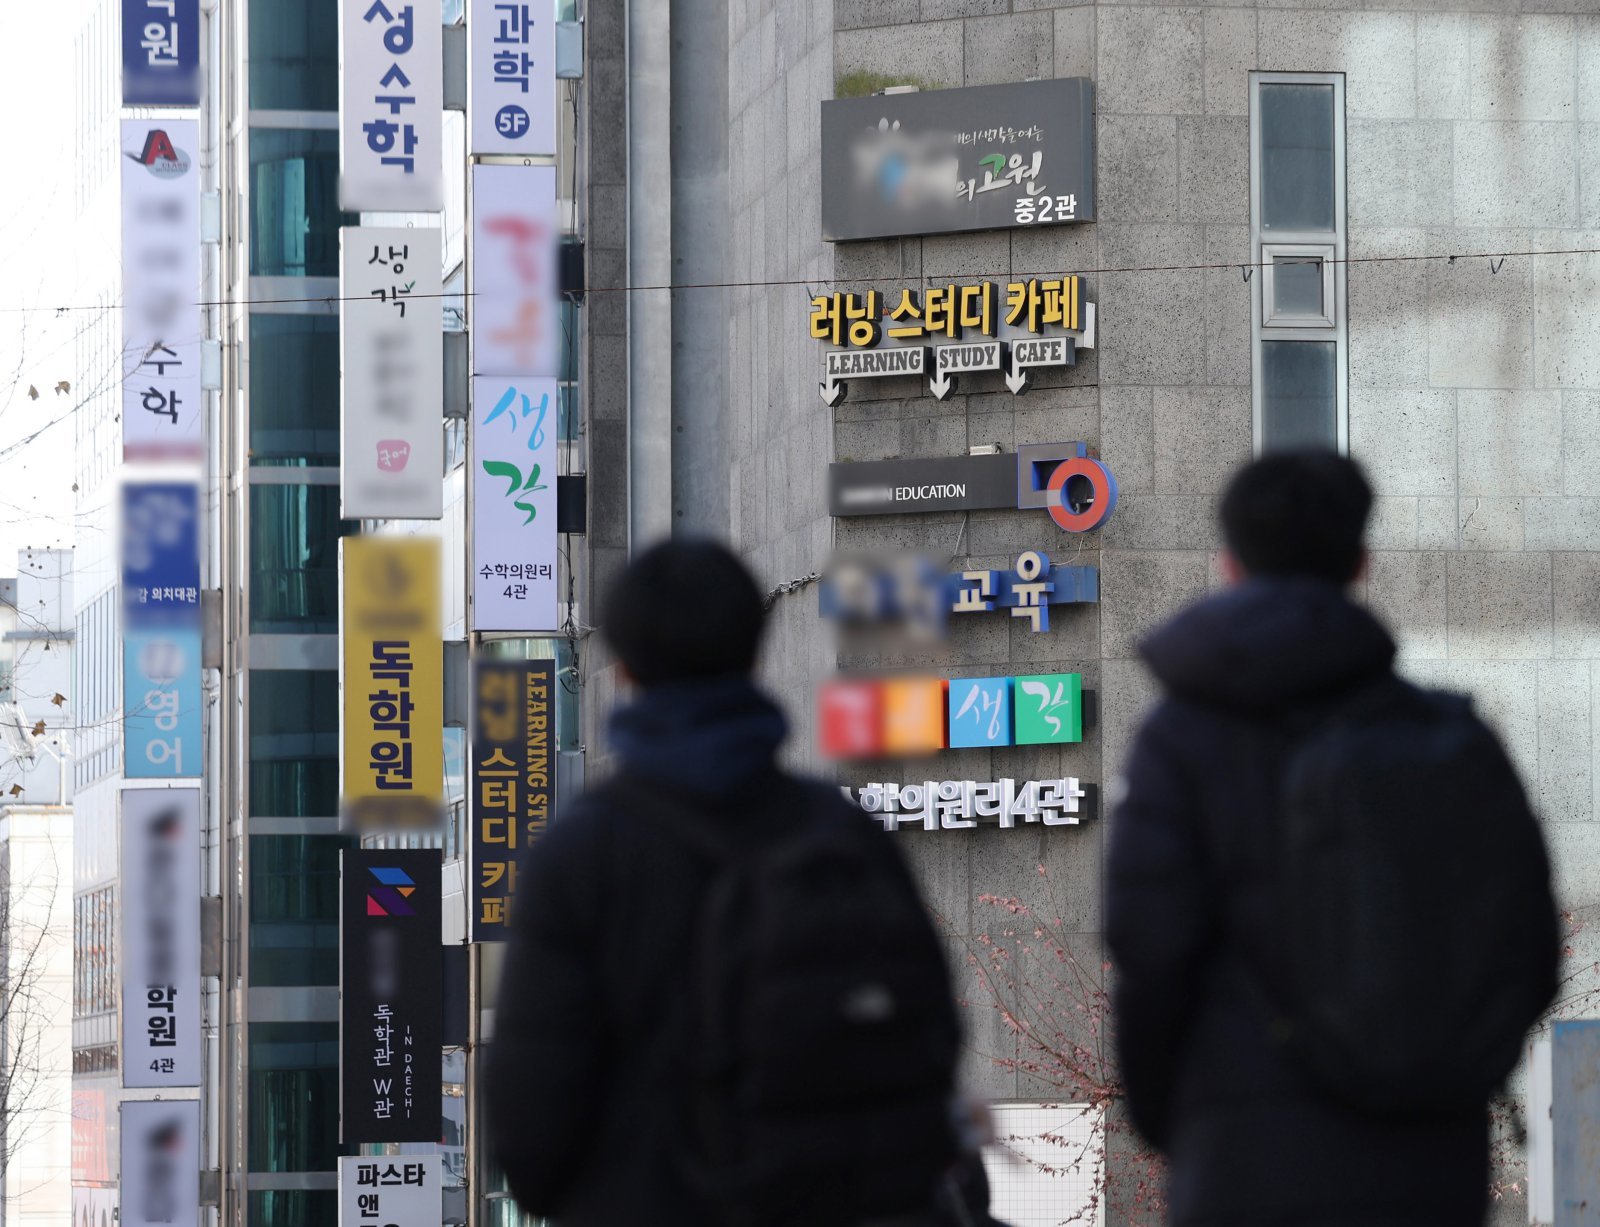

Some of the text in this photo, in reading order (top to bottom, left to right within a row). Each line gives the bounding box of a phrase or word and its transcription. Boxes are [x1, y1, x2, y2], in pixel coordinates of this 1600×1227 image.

[499, 113, 526, 132] 5F
[1014, 194, 1077, 223] 중2관
[368, 244, 415, 318] 생각
[810, 275, 1078, 347] 러닝 스터디 카페
[141, 341, 182, 424] 수학
[829, 341, 1061, 375] LEARNING STUDY CAFE
[482, 386, 548, 526] 생각
[895, 484, 966, 501] EDUCATION
[480, 563, 552, 580] 수학의원리
[503, 584, 528, 600] 4관
[144, 689, 182, 774] 영어
[369, 640, 415, 790] 독학원
[527, 672, 548, 787] LEARNING
[955, 681, 1069, 740] 생각
[478, 748, 519, 849] 스터디
[373, 1004, 395, 1066] 독학관
[149, 1058, 176, 1074] 4관
[404, 1025, 413, 1119] IN DAECHI
[357, 1163, 426, 1187] 파스타
[357, 1194, 380, 1218] 앤
